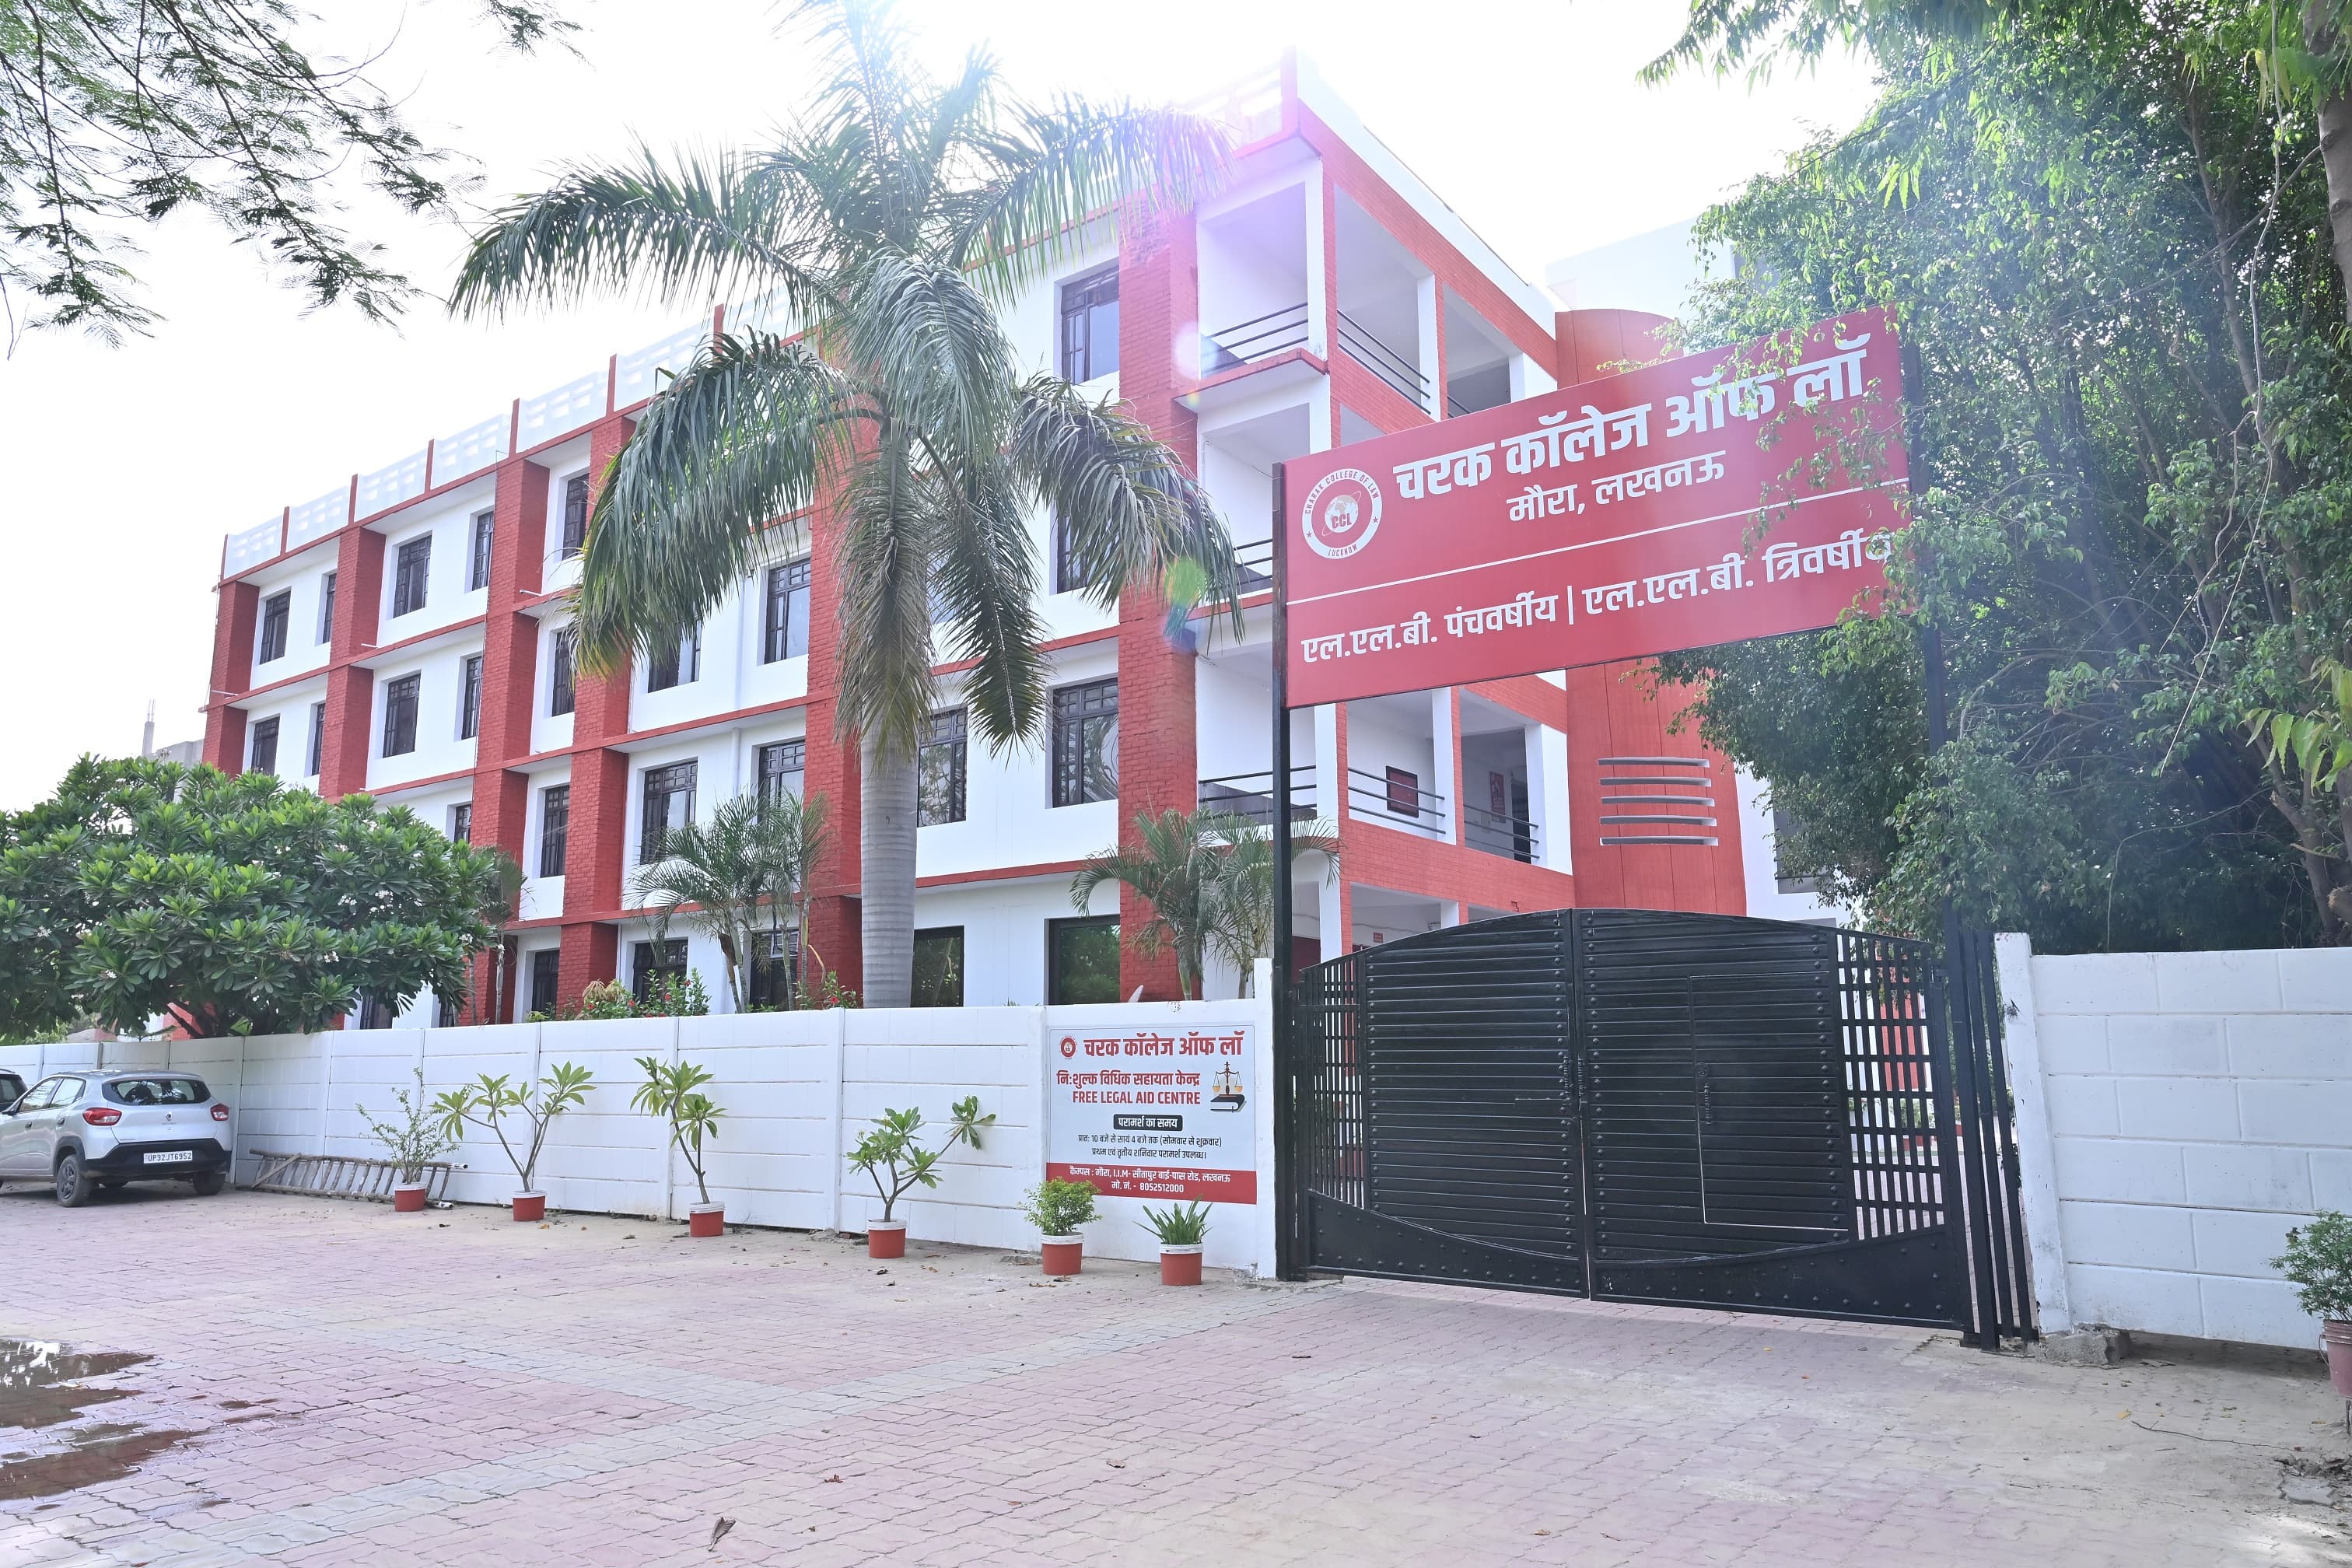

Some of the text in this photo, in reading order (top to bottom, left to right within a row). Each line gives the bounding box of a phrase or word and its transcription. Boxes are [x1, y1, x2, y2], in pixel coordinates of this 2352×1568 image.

[1392, 333, 1871, 499] चरक कॉलेज ऑफ लॉ
[1304, 470, 1379, 514] CHARAK COLLEGE OF LAW
[1506, 450, 1727, 522] मौरा, लखनऊ
[1331, 513, 1352, 529] CCL
[1328, 544, 1357, 557] LUCKNOW
[1300, 611, 1438, 663] एल.एल.बी.
[1444, 590, 1559, 638] पंचवर्षीय
[1581, 552, 1754, 614] एल.एल.बी.
[1083, 1031, 1245, 1056] चरक कॉलेज ऑफ लॉ
[1099, 1069, 1132, 1085] विधिक
[1132, 1073, 1174, 1085] सहायता
[1175, 1069, 1201, 1087] केन्द्र
[1073, 1090, 1201, 1104] FREE LEGAL AID CENTRE
[1118, 1115, 1178, 1128] परामर्श का समय
[1099, 1133, 1109, 1143] बजे
[1110, 1133, 1116, 1143] से
[1136, 1134, 1146, 1144] बजे
[1160, 1135, 1187, 1146] (सोमवार
[1188, 1136, 1195, 1145] से
[1196, 1136, 1222, 1147] शुक्रवार)
[148, 1153, 192, 1162] UP32JT6952
[1092, 1147, 1107, 1156] प्रथम
[1108, 1147, 1116, 1156] एवं
[1117, 1146, 1132, 1159] तृतीय
[1133, 1148, 1157, 1157] शनिवार
[1158, 1149, 1181, 1158] परामर्श
[1069, 1165, 1090, 1176] कैम्पस
[1095, 1167, 1111, 1178] मौरा,
[1132, 1168, 1157, 1181] सीतापुर
[1158, 1170, 1186, 1180] बाई-पास
[1187, 1171, 1201, 1182] रोड,
[1202, 1173, 1230, 1182] लखनऊ
[1111, 1179, 1122, 1189] मो.
[1123, 1180, 1132, 1190] नं.
[1139, 1182, 1184, 1192] 8052512000
